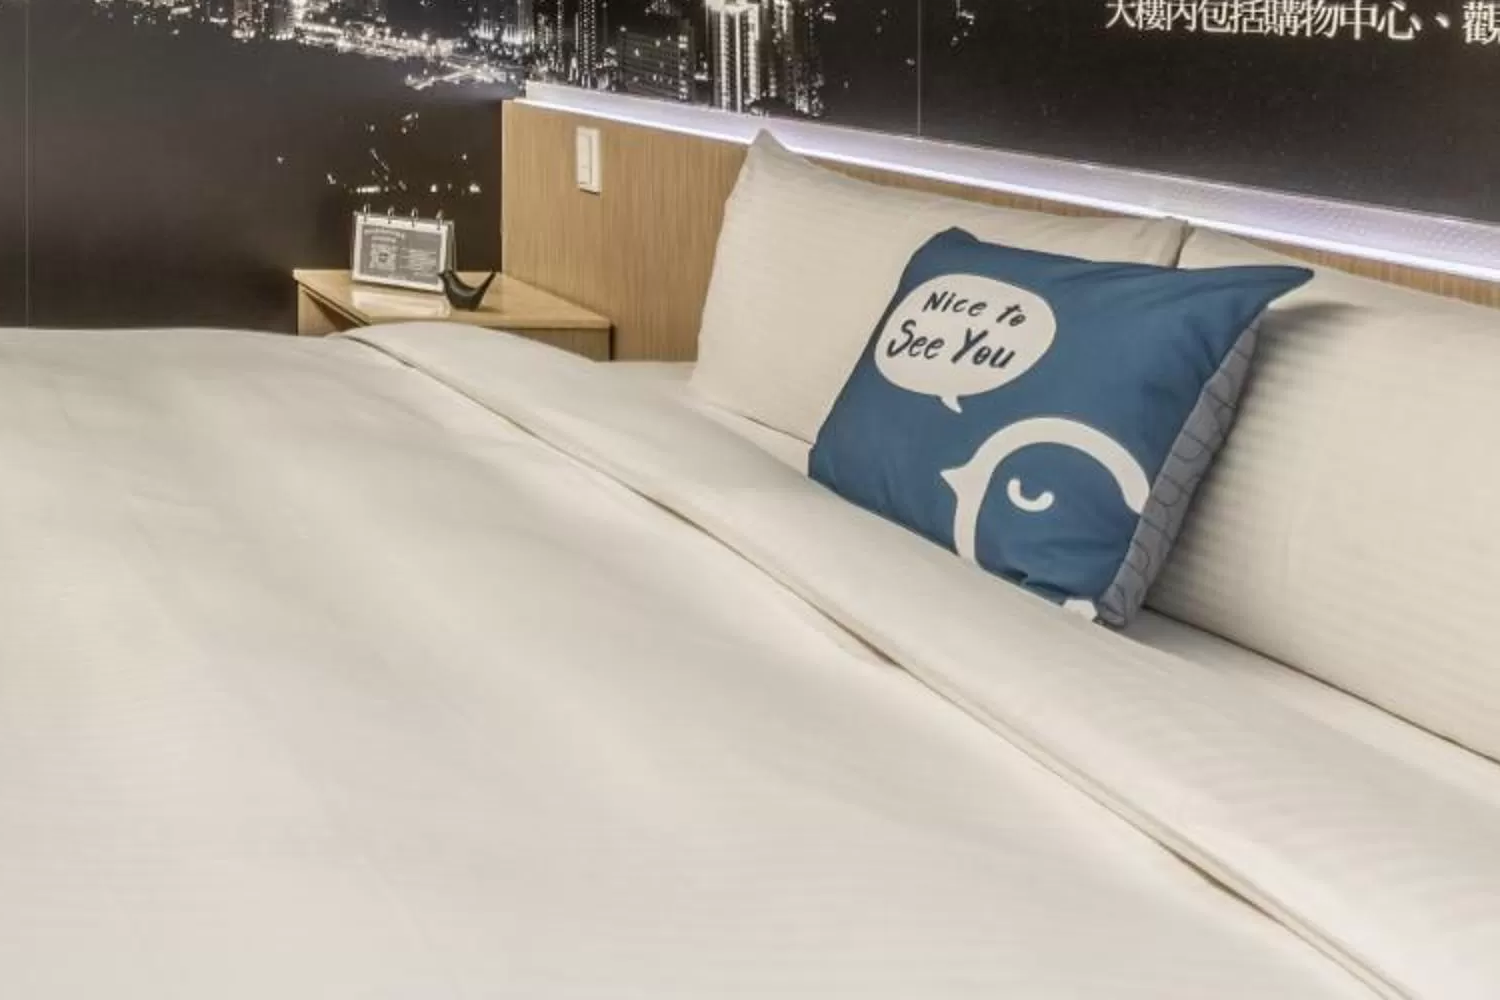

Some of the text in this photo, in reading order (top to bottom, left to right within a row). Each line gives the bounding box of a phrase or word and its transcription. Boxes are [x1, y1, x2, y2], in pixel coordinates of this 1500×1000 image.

[922, 291, 1026, 327] Nice to
[886, 319, 1016, 369] See You
